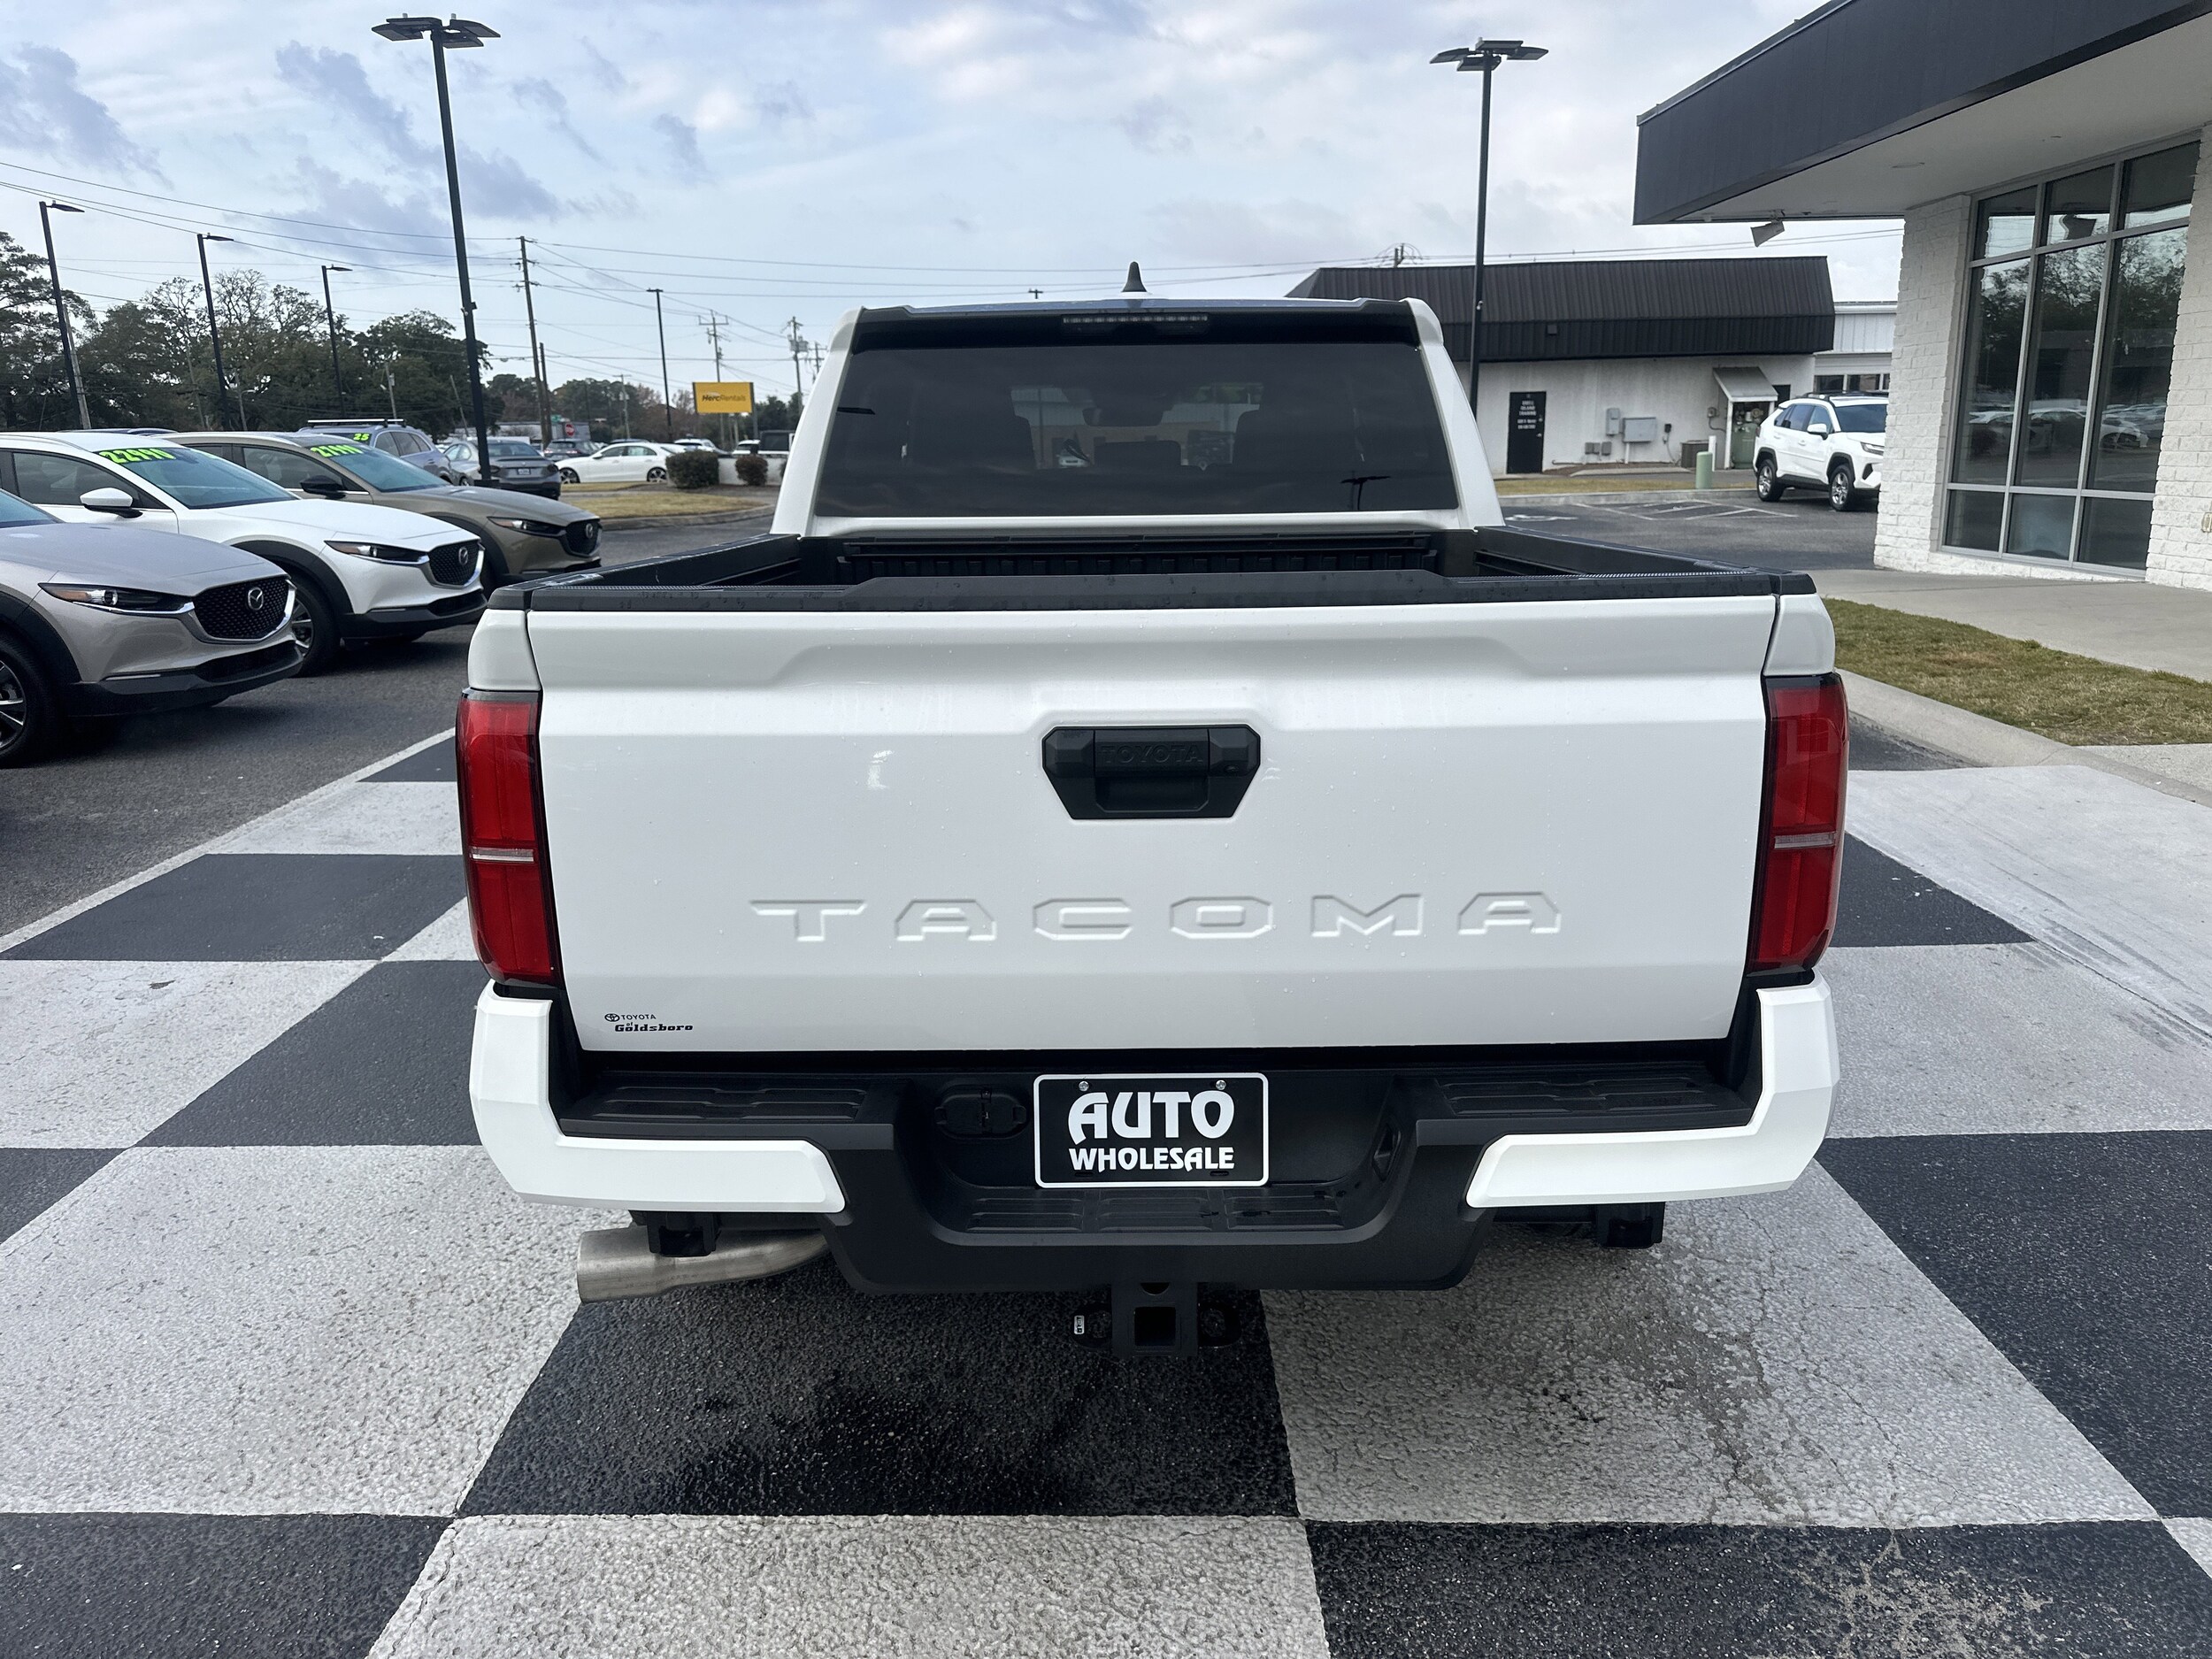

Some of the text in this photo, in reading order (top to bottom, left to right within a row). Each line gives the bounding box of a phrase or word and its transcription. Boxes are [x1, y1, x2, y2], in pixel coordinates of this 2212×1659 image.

[98, 448, 177, 464] 22990
[1100, 743, 1204, 764] TOYOTA
[748, 890, 1562, 942] TACOMA
[615, 1024, 693, 1033] Goldsboro
[1067, 1089, 1235, 1146] AUTO
[1068, 1146, 1235, 1173] WHOLESALE
